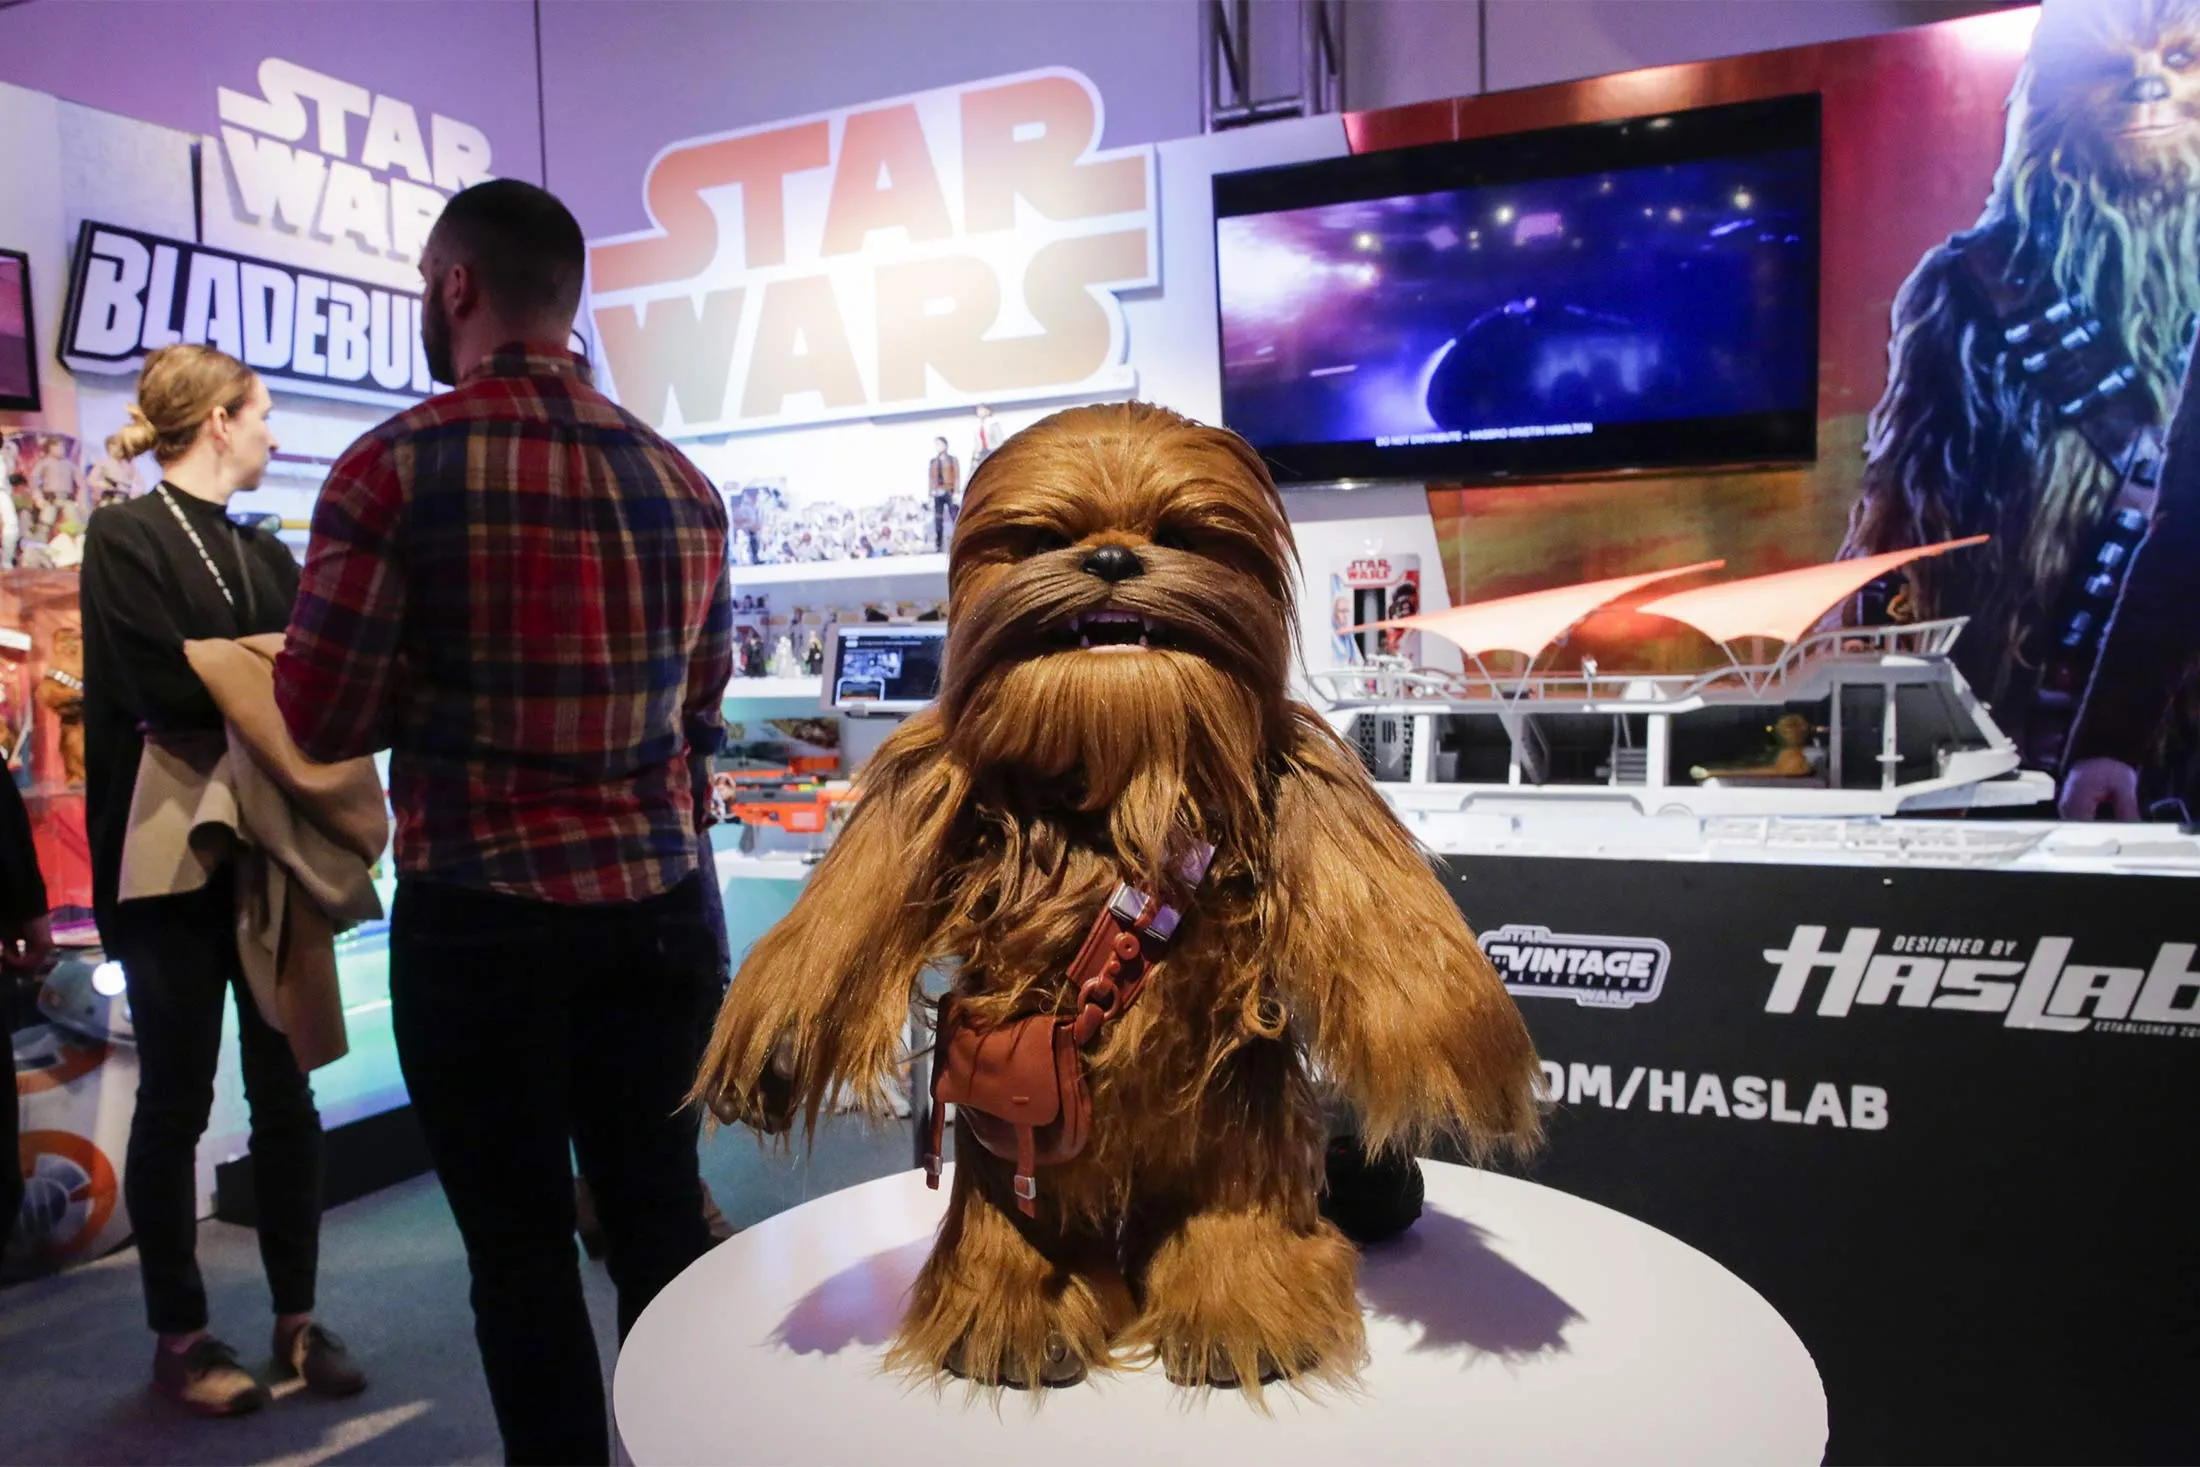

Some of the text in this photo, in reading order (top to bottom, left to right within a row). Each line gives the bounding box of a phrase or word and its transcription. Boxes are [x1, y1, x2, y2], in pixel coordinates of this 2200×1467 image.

[217, 57, 496, 194] STAR
[220, 125, 450, 256] WAR
[590, 76, 1147, 294] STAR
[593, 228, 1148, 428] WARS
[1347, 559, 1392, 571] STAR
[1489, 945, 1655, 978] VINTAGE
[1892, 935, 2018, 957] DESIGNED BY
[1537, 1059, 1889, 1130] OM/HASLAB
